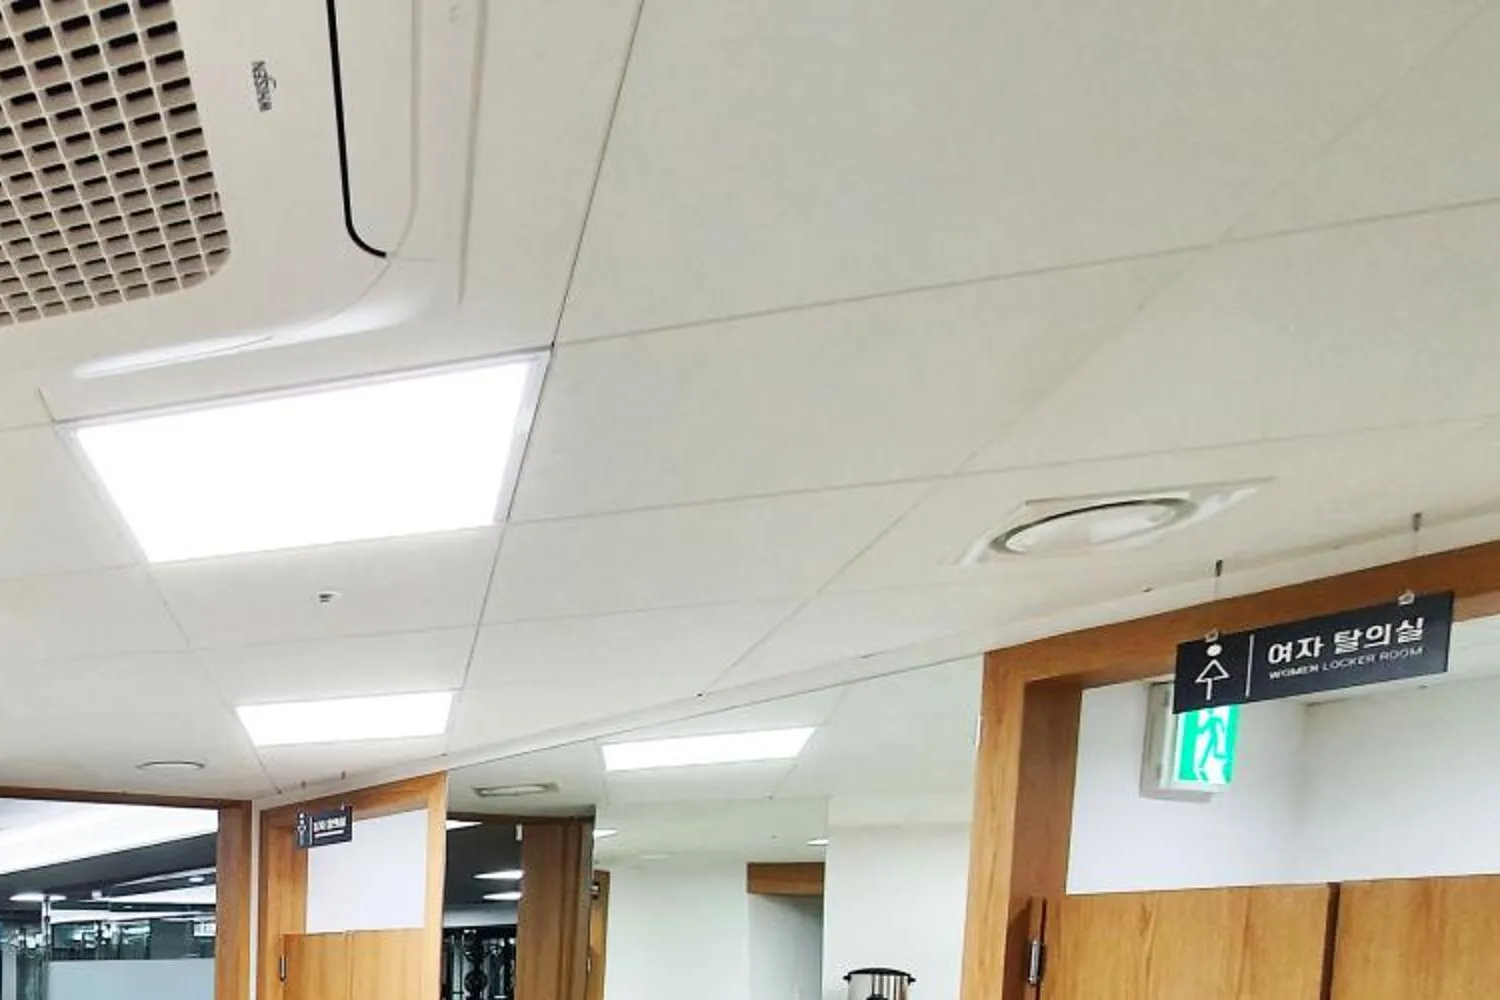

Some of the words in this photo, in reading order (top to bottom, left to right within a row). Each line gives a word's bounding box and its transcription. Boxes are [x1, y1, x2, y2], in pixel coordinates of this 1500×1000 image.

[1267, 635, 1325, 665] 여자
[1333, 617, 1425, 655] 탈의실
[1268, 664, 1320, 680] WOMEN
[1322, 655, 1376, 673] LOCKER
[1378, 646, 1424, 662] ROOM
